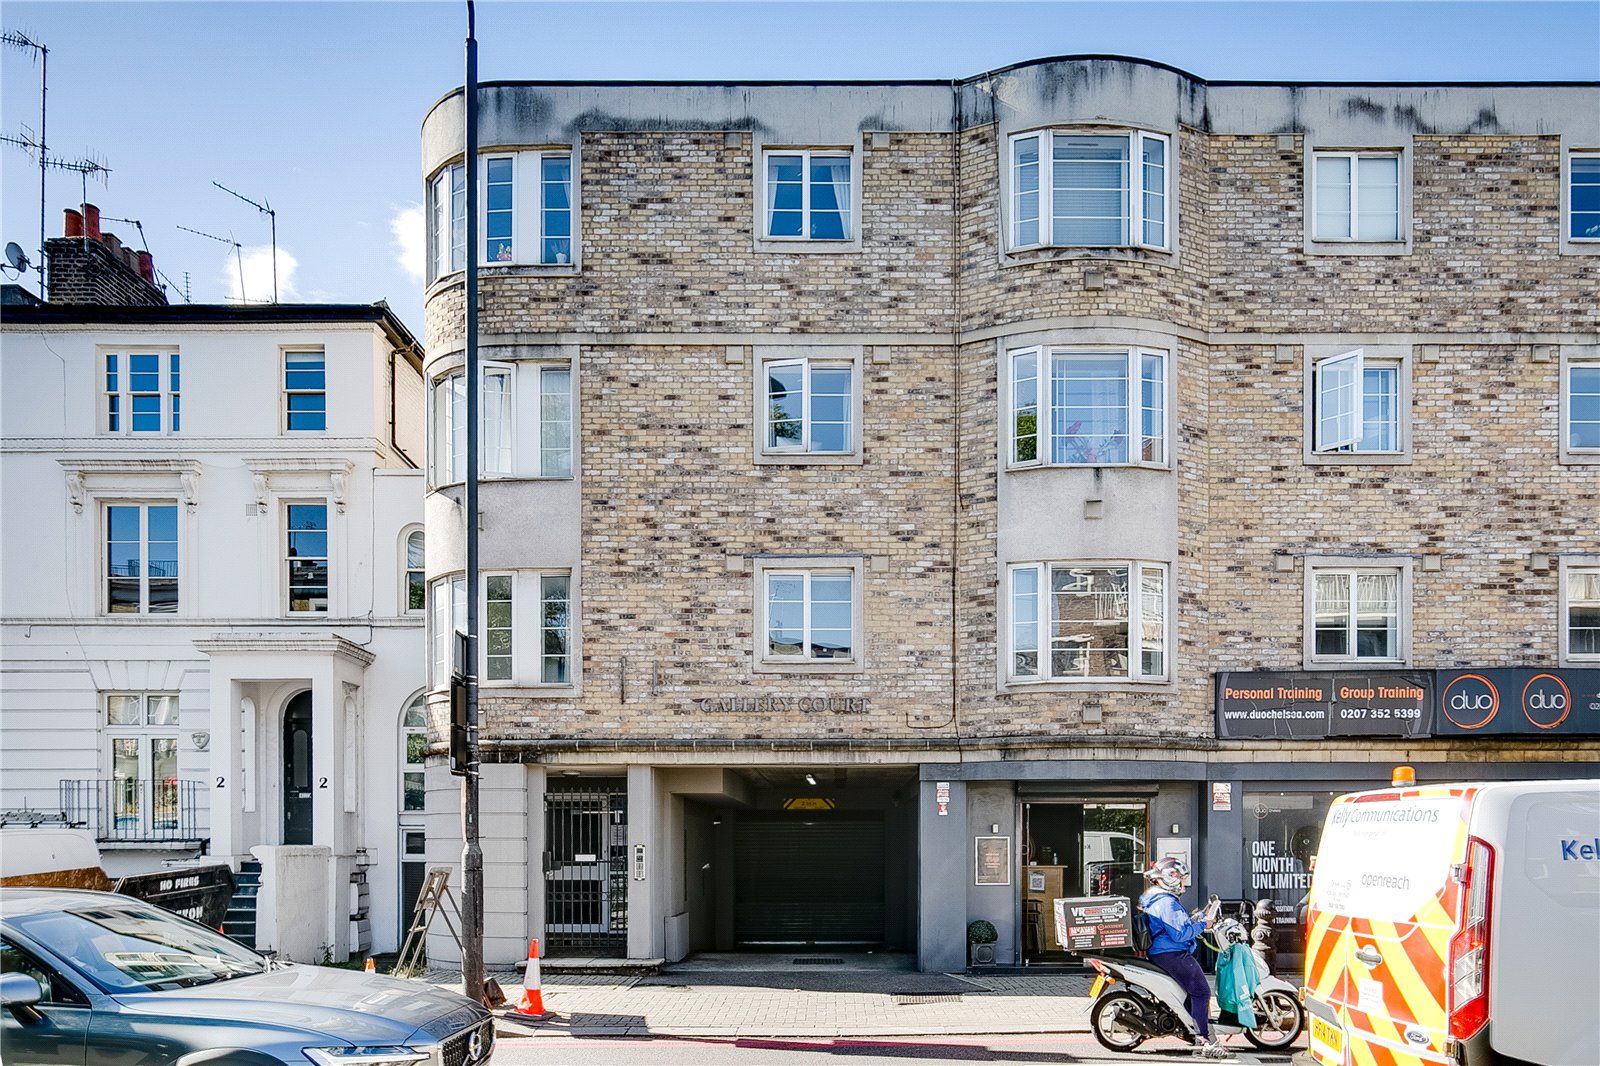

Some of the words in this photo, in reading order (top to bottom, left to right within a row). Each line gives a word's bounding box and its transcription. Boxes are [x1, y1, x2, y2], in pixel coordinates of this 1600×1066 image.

[1225, 688, 1274, 699] Personal
[1277, 687, 1323, 701] Training
[1340, 687, 1375, 700] Group
[1378, 687, 1424, 701] Training
[1451, 689, 1494, 710] duo
[1529, 688, 1567, 709] duo
[700, 697, 793, 713] GALLERY
[798, 697, 872, 713] COURT
[1340, 709, 1368, 719] 0207
[1370, 709, 1391, 719] 352
[1394, 709, 1421, 719] 5399
[216, 776, 225, 788] 2
[319, 777, 328, 788] 2
[1332, 806, 1351, 828] Kelly
[1351, 805, 1440, 823] Communications
[1252, 841, 1275, 856] ONE
[1252, 857, 1294, 872] MONTH
[160, 880, 173, 891] NO
[175, 876, 200, 889] FIRES
[1361, 873, 1410, 889] openreach
